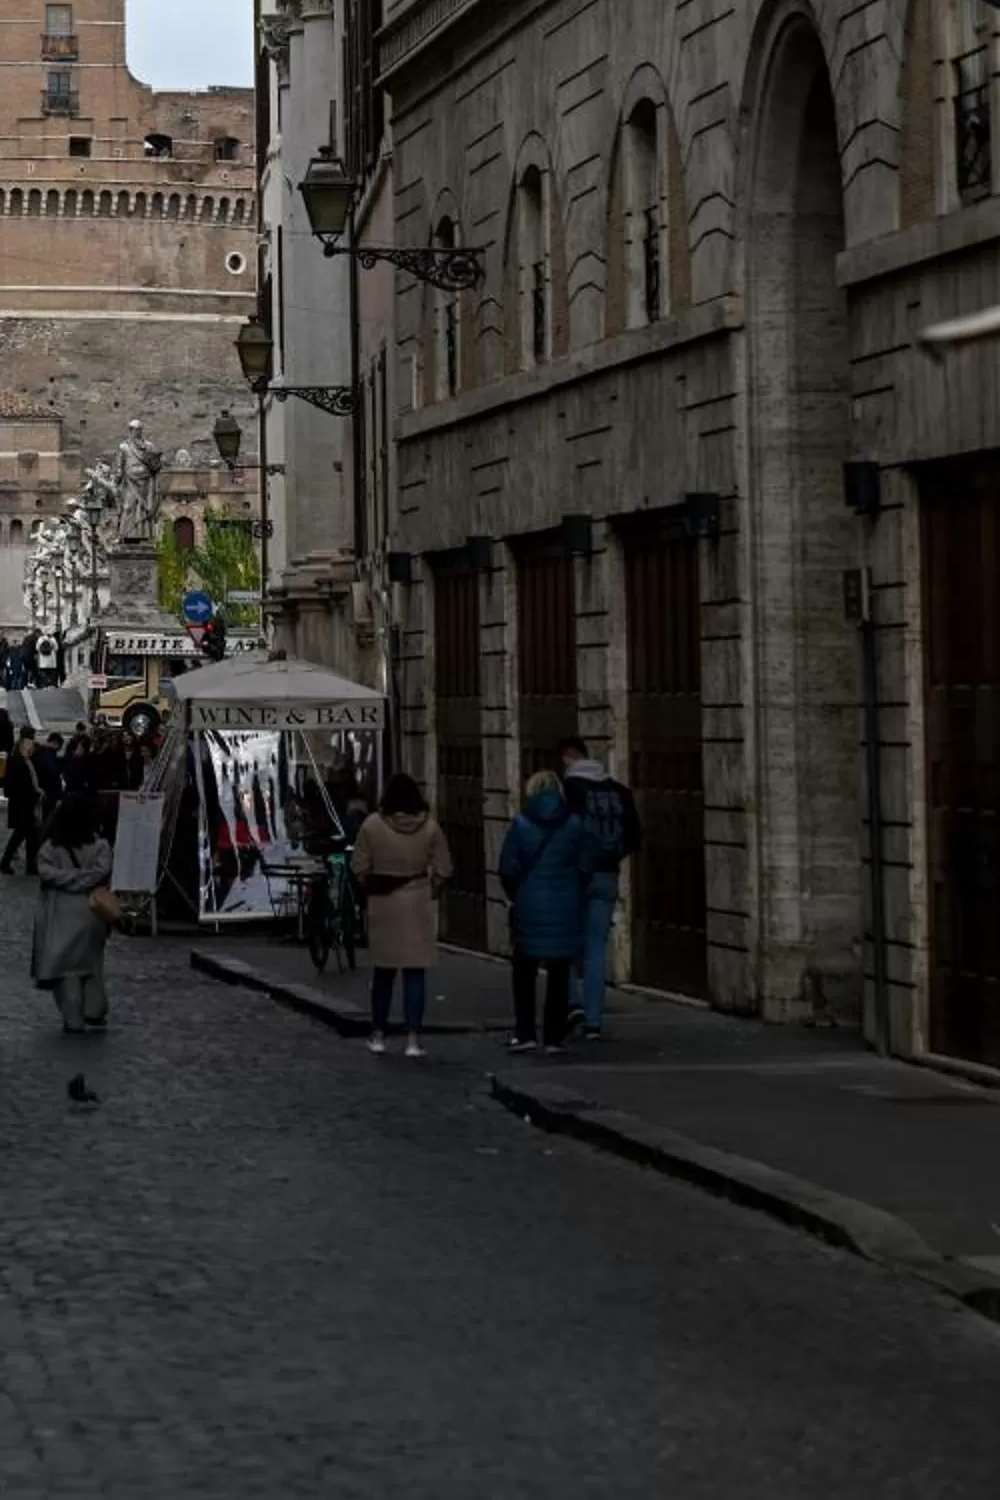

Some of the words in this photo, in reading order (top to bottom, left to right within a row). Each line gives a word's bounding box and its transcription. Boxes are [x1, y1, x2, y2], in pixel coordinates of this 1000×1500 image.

[115, 638, 183, 649] BIBITE
[199, 706, 277, 724] WINE
[285, 707, 306, 725] &
[316, 706, 378, 724] BAR
